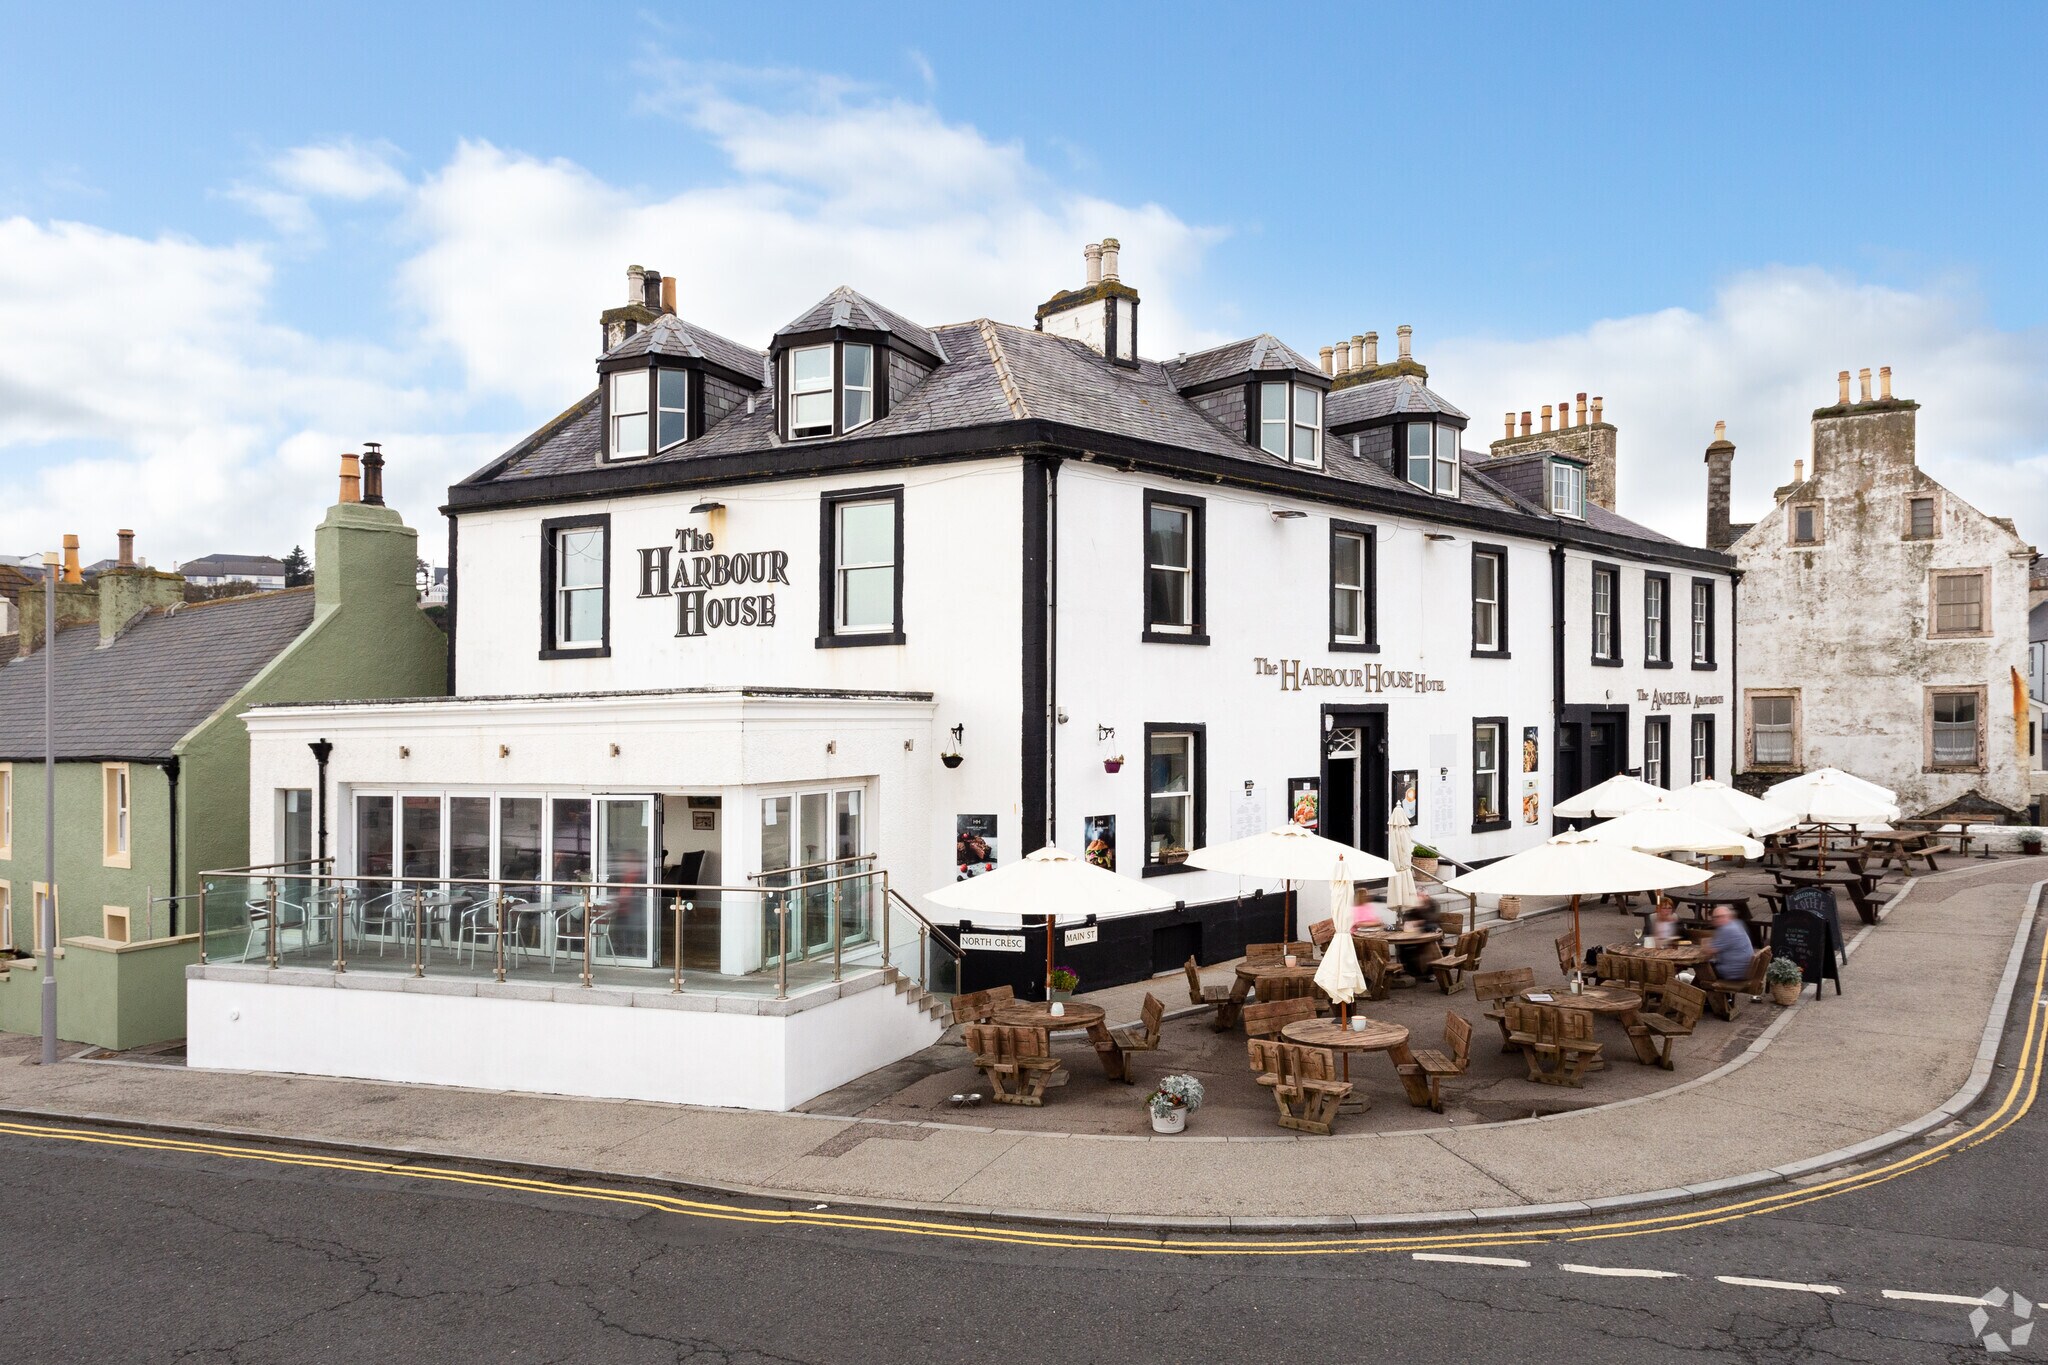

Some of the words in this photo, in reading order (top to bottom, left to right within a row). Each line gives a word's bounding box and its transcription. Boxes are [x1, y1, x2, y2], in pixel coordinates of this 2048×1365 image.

[675, 527, 714, 553] The
[636, 546, 790, 599] HARBOUR
[674, 590, 776, 638] HOUSE
[1254, 657, 1278, 675] The
[1280, 659, 1364, 691] HARBOUR
[1364, 663, 1413, 692] HOUSE
[1414, 673, 1446, 693] HOTEL
[1636, 688, 1649, 701] The
[1651, 688, 1691, 710] ANGLESEA
[961, 937, 992, 947] NORTH
[994, 938, 1022, 948] CRESC
[1066, 931, 1085, 943] MAIN
[1086, 930, 1095, 939] ST
